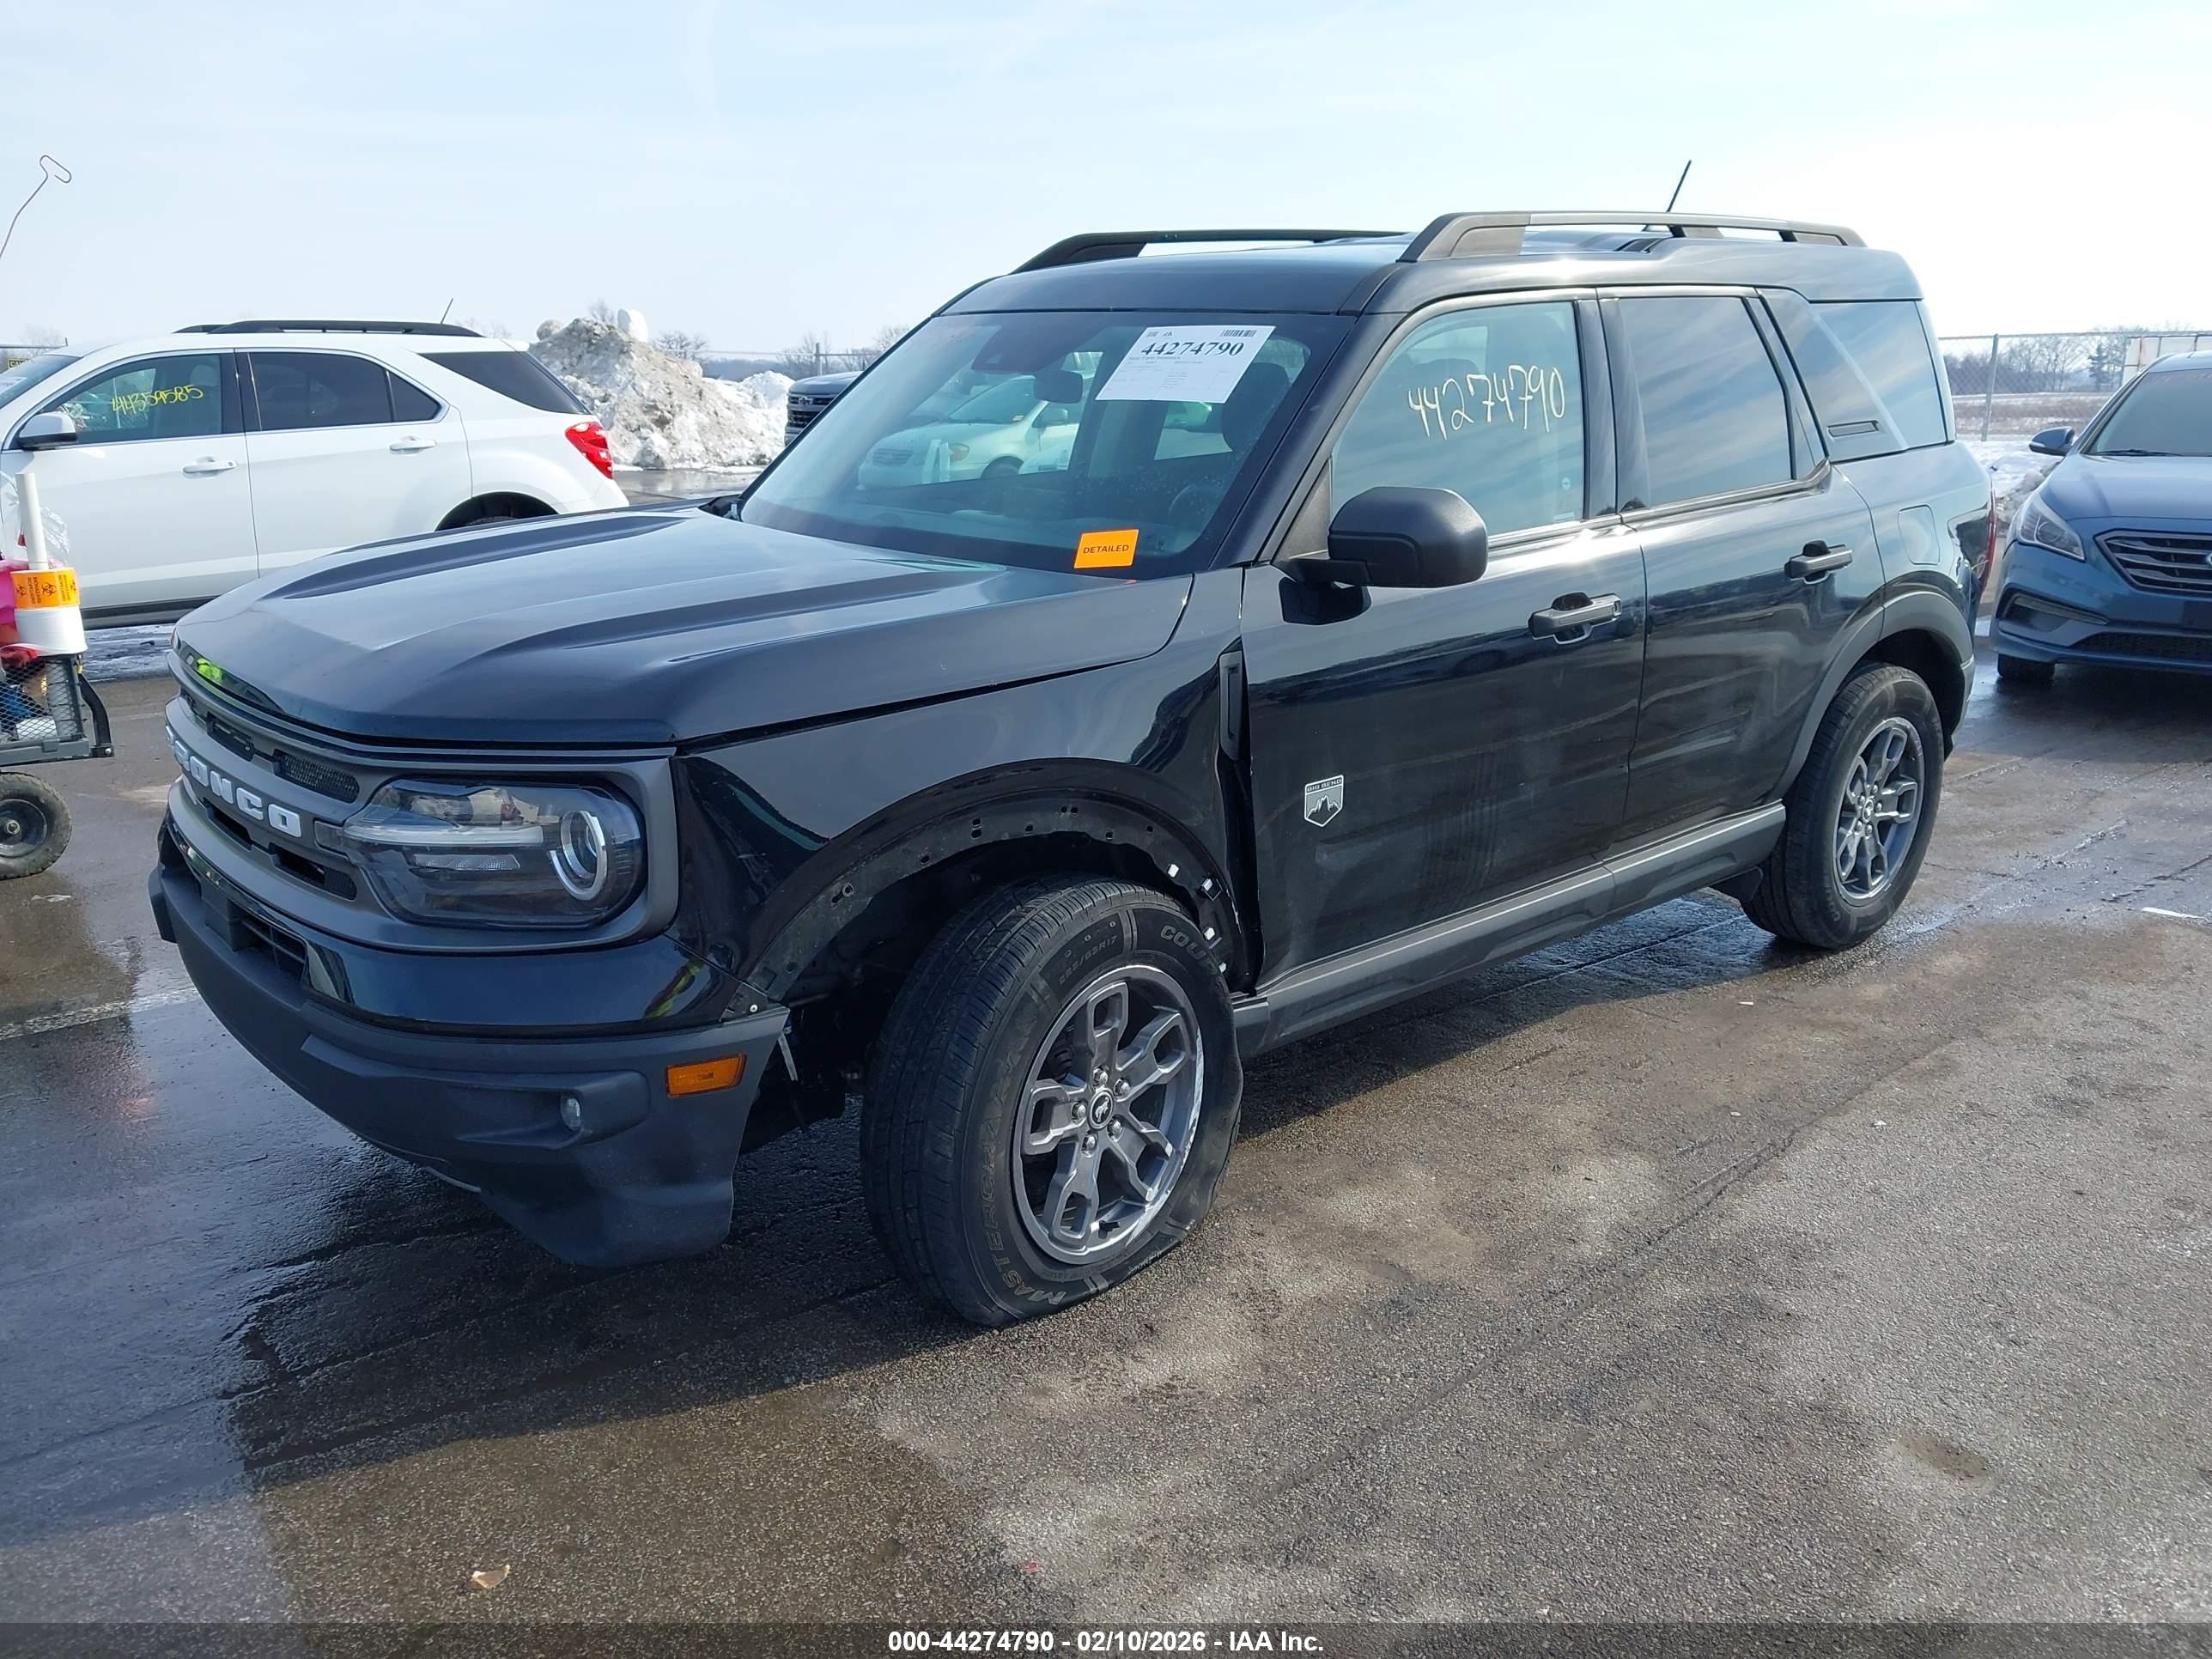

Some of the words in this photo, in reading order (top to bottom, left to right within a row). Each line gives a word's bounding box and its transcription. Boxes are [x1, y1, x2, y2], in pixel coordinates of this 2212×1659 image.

[1140, 342, 1244, 356] 44274790
[112, 384, 204, 416] 44359585
[1407, 365, 1565, 441] 44274790
[1083, 544, 1130, 555] DETAILED
[166, 726, 302, 838] BRONCO
[1321, 779, 1341, 789] BEND
